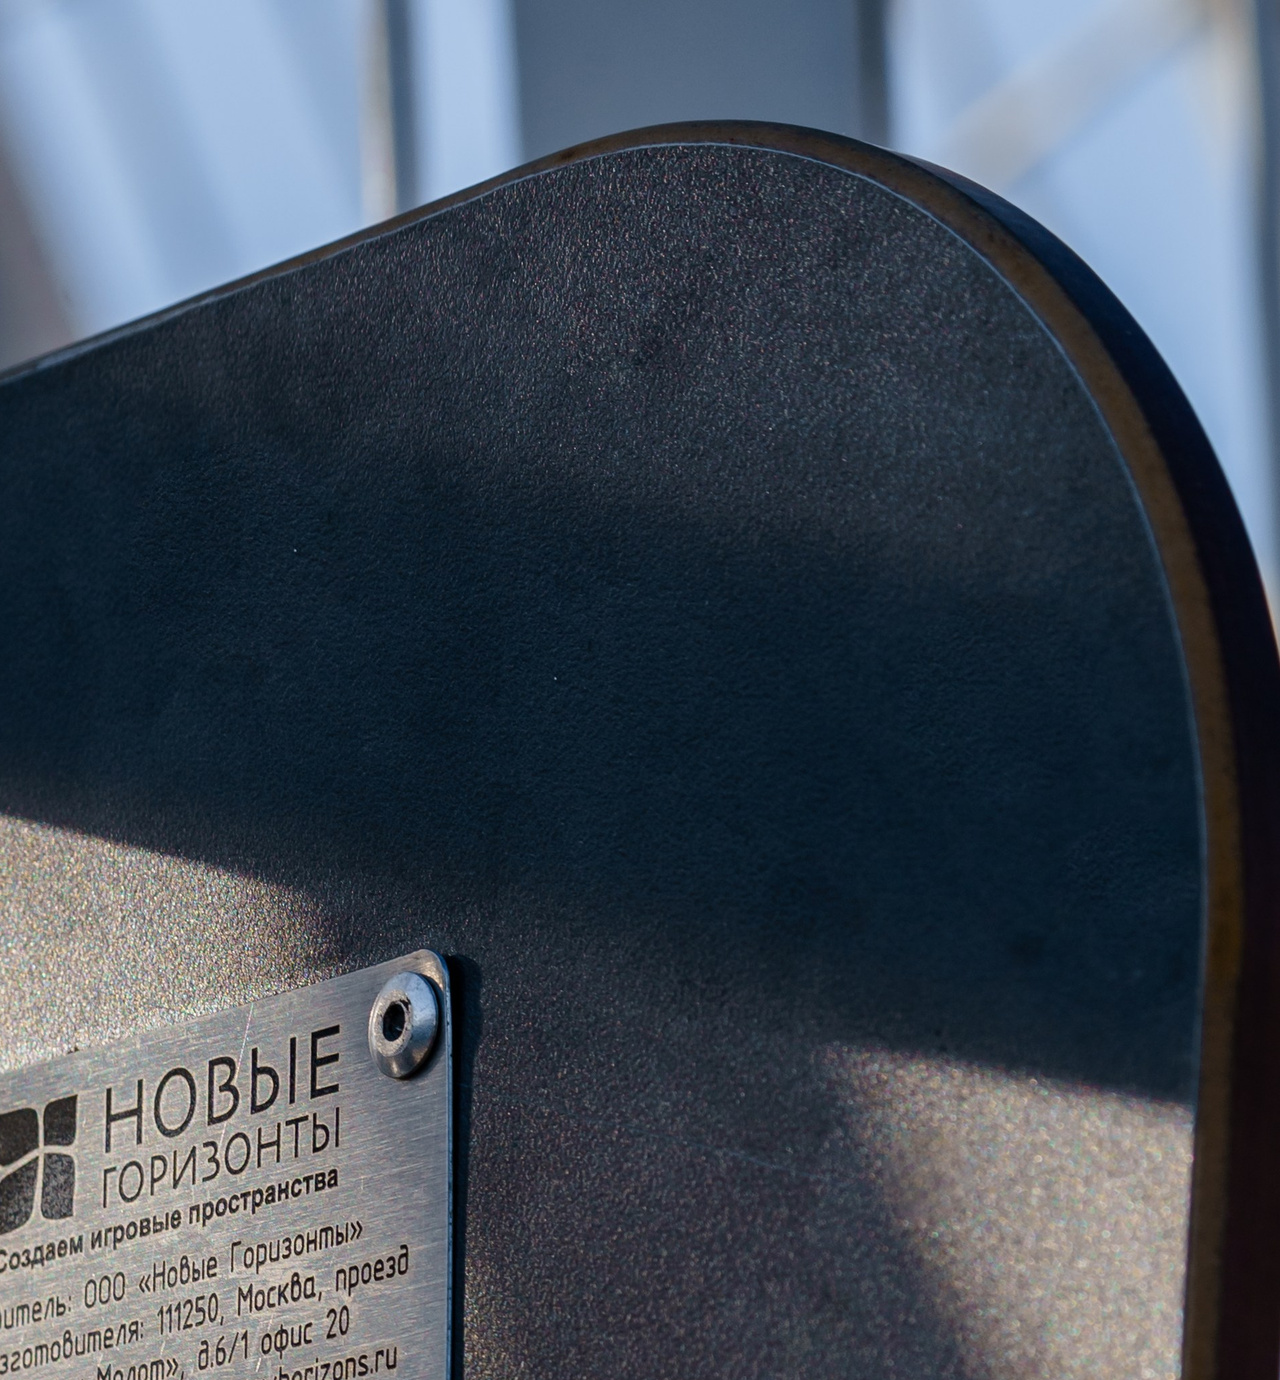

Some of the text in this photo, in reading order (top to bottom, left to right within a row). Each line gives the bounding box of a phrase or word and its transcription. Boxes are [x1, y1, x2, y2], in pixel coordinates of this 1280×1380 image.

[105, 1025, 341, 1153] НОВЫЕ
[102, 1107, 341, 1208] ГОРИЗОНТЫ
[91, 1209, 182, 1252] игровые
[189, 1169, 339, 1226] пространства
[84, 1273, 126, 1309] ООО
[139, 1257, 218, 1294] «Новые
[230, 1220, 364, 1274] Горизонты»
[157, 1292, 224, 1336] 111250,
[237, 1277, 323, 1319] Москва,
[335, 1245, 409, 1294] проезд
[198, 1332, 249, 1370] д.6/1
[261, 1324, 313, 1360] офис
[326, 1305, 350, 1341] 20
